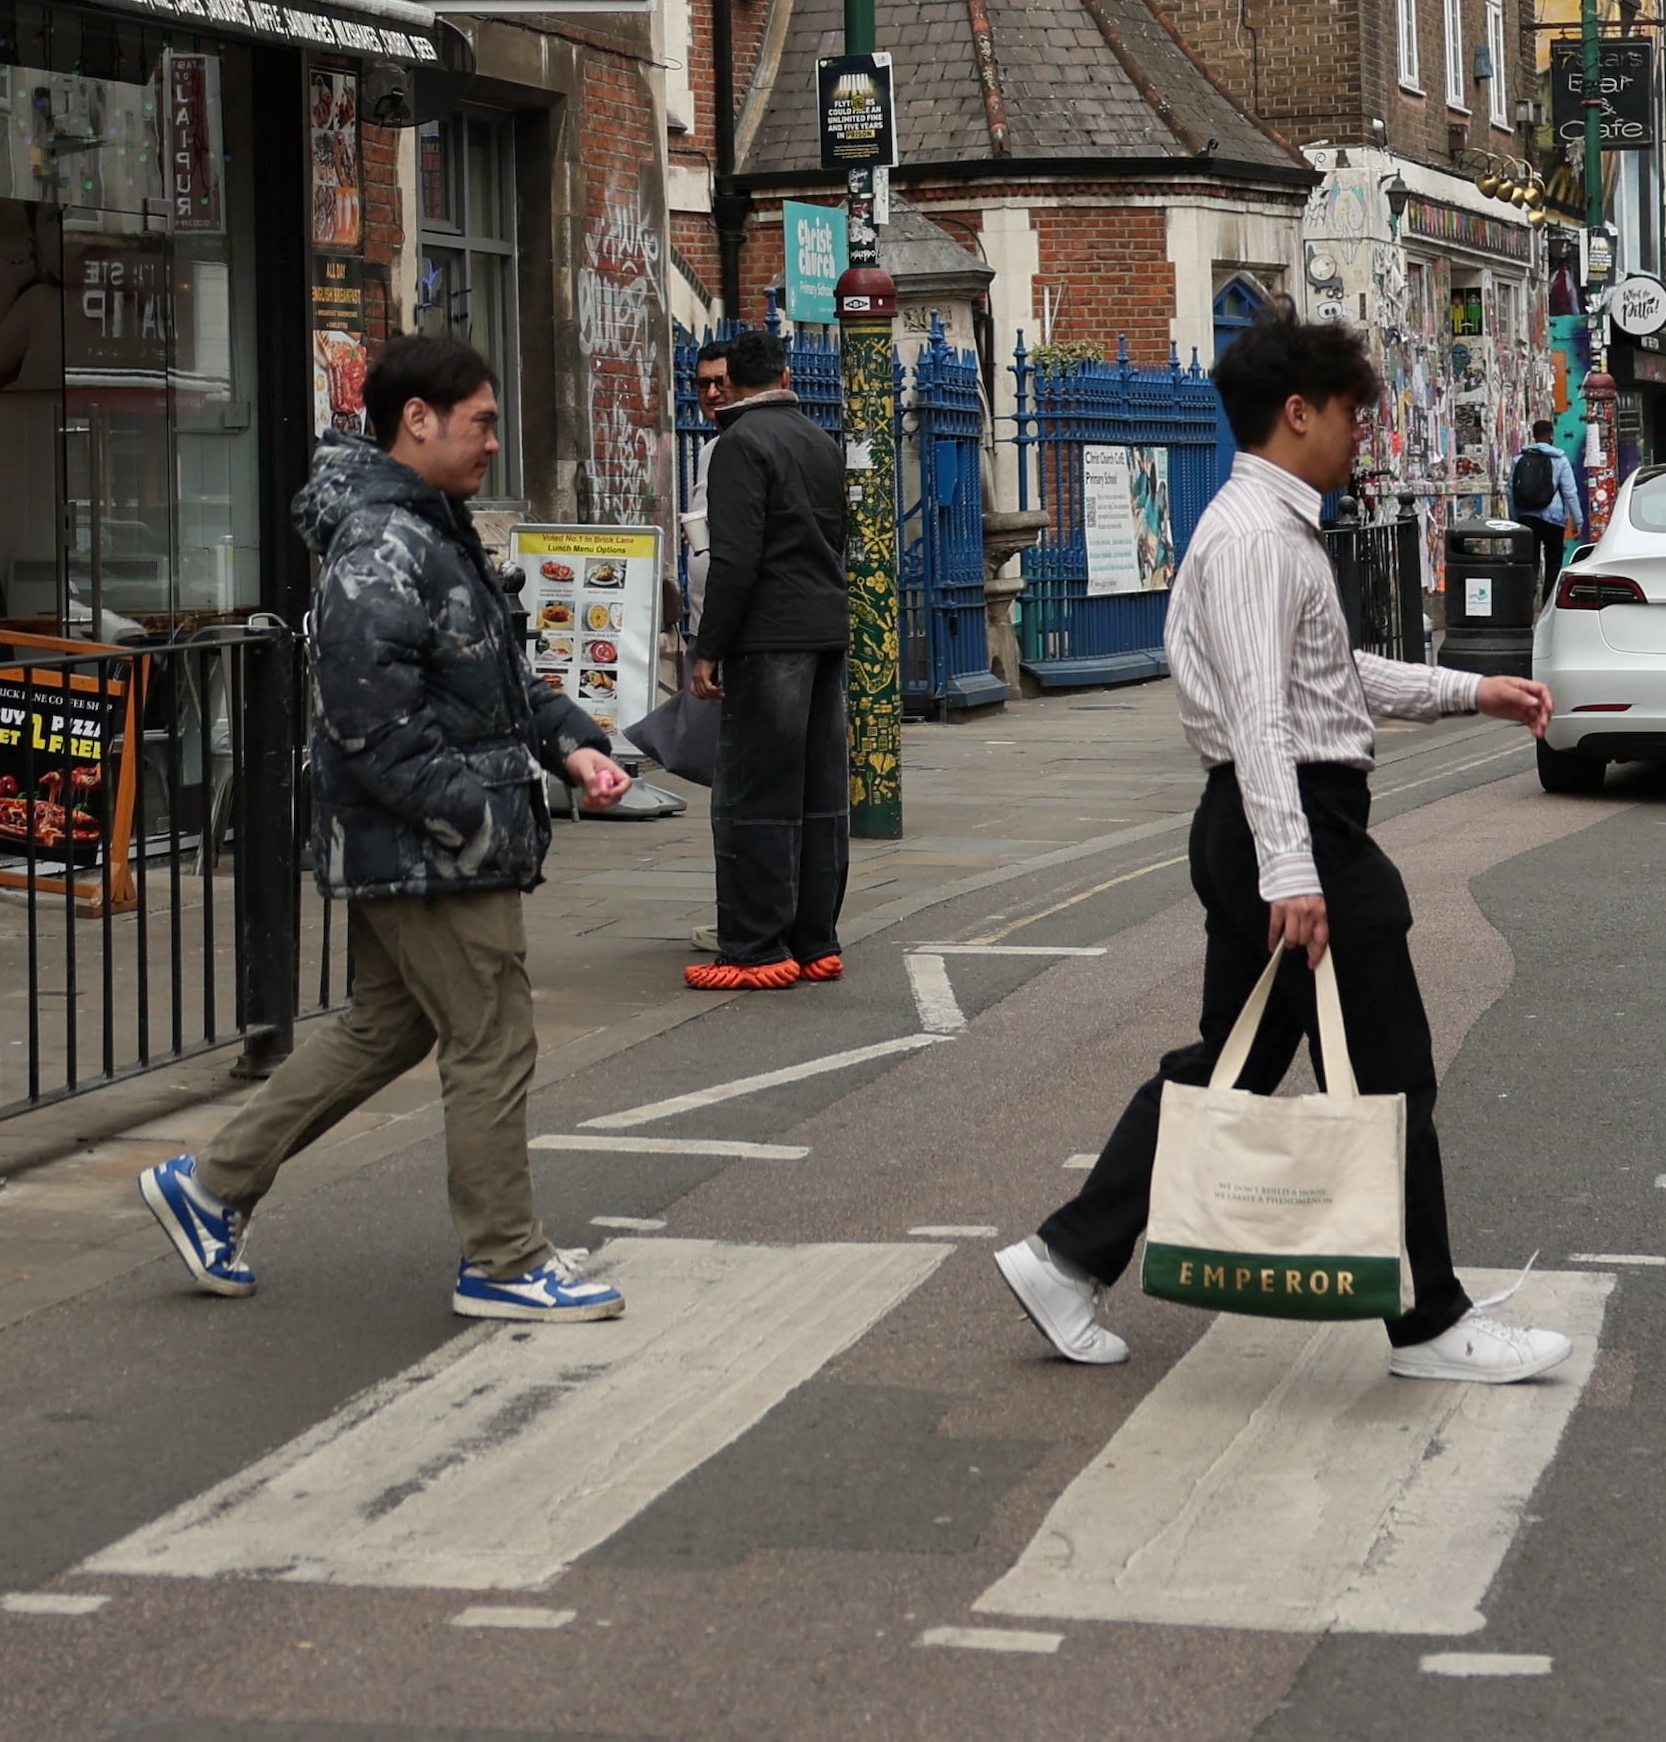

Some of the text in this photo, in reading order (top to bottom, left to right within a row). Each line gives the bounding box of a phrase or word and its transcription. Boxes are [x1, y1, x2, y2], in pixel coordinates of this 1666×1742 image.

[827, 113, 883, 124] UNLIMITED FINE
[828, 107, 852, 116] COULD
[827, 121, 884, 132] AND FIVE YEARS
[836, 131, 845, 139] IN
[1560, 118, 1643, 140] Cafe
[797, 215, 833, 254] Christ
[326, 262, 346, 279] ALL DAY
[311, 285, 361, 305] ENGLISH BREAKFAST
[799, 280, 817, 298] Primary
[1622, 299, 1660, 327] Pitta!
[1085, 471, 1118, 489] Primary School
[542, 533, 564, 542] Voted
[593, 535, 615, 544] Brick
[616, 536, 635, 544] Lane
[547, 544, 626, 555] Lunch Menu Options
[1179, 1261, 1355, 1295] EMPEROR
